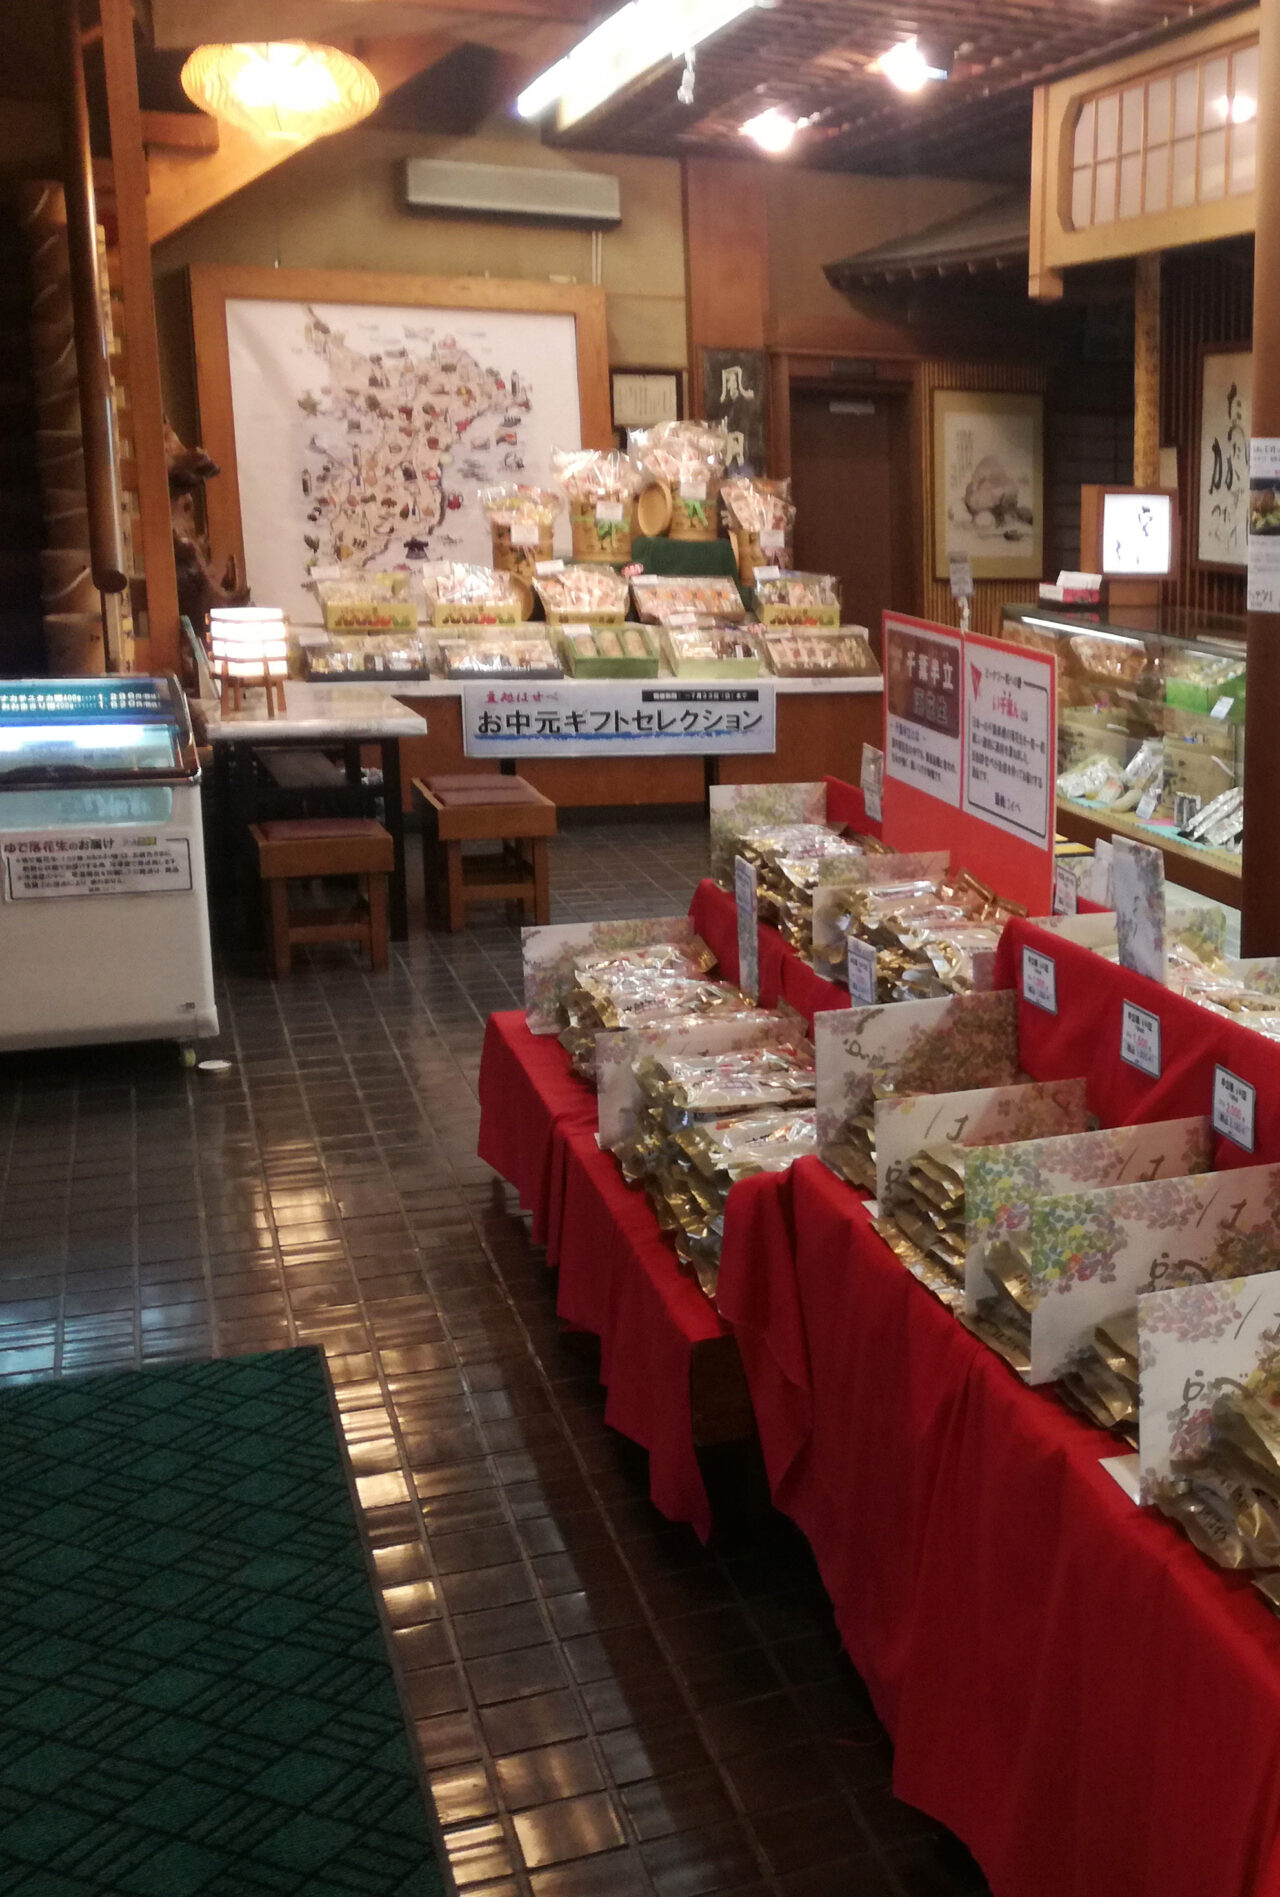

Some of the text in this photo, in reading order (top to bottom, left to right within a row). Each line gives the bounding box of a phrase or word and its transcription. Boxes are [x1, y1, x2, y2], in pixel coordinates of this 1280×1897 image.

[477, 708, 764, 735] お中元ギフトセレクション
